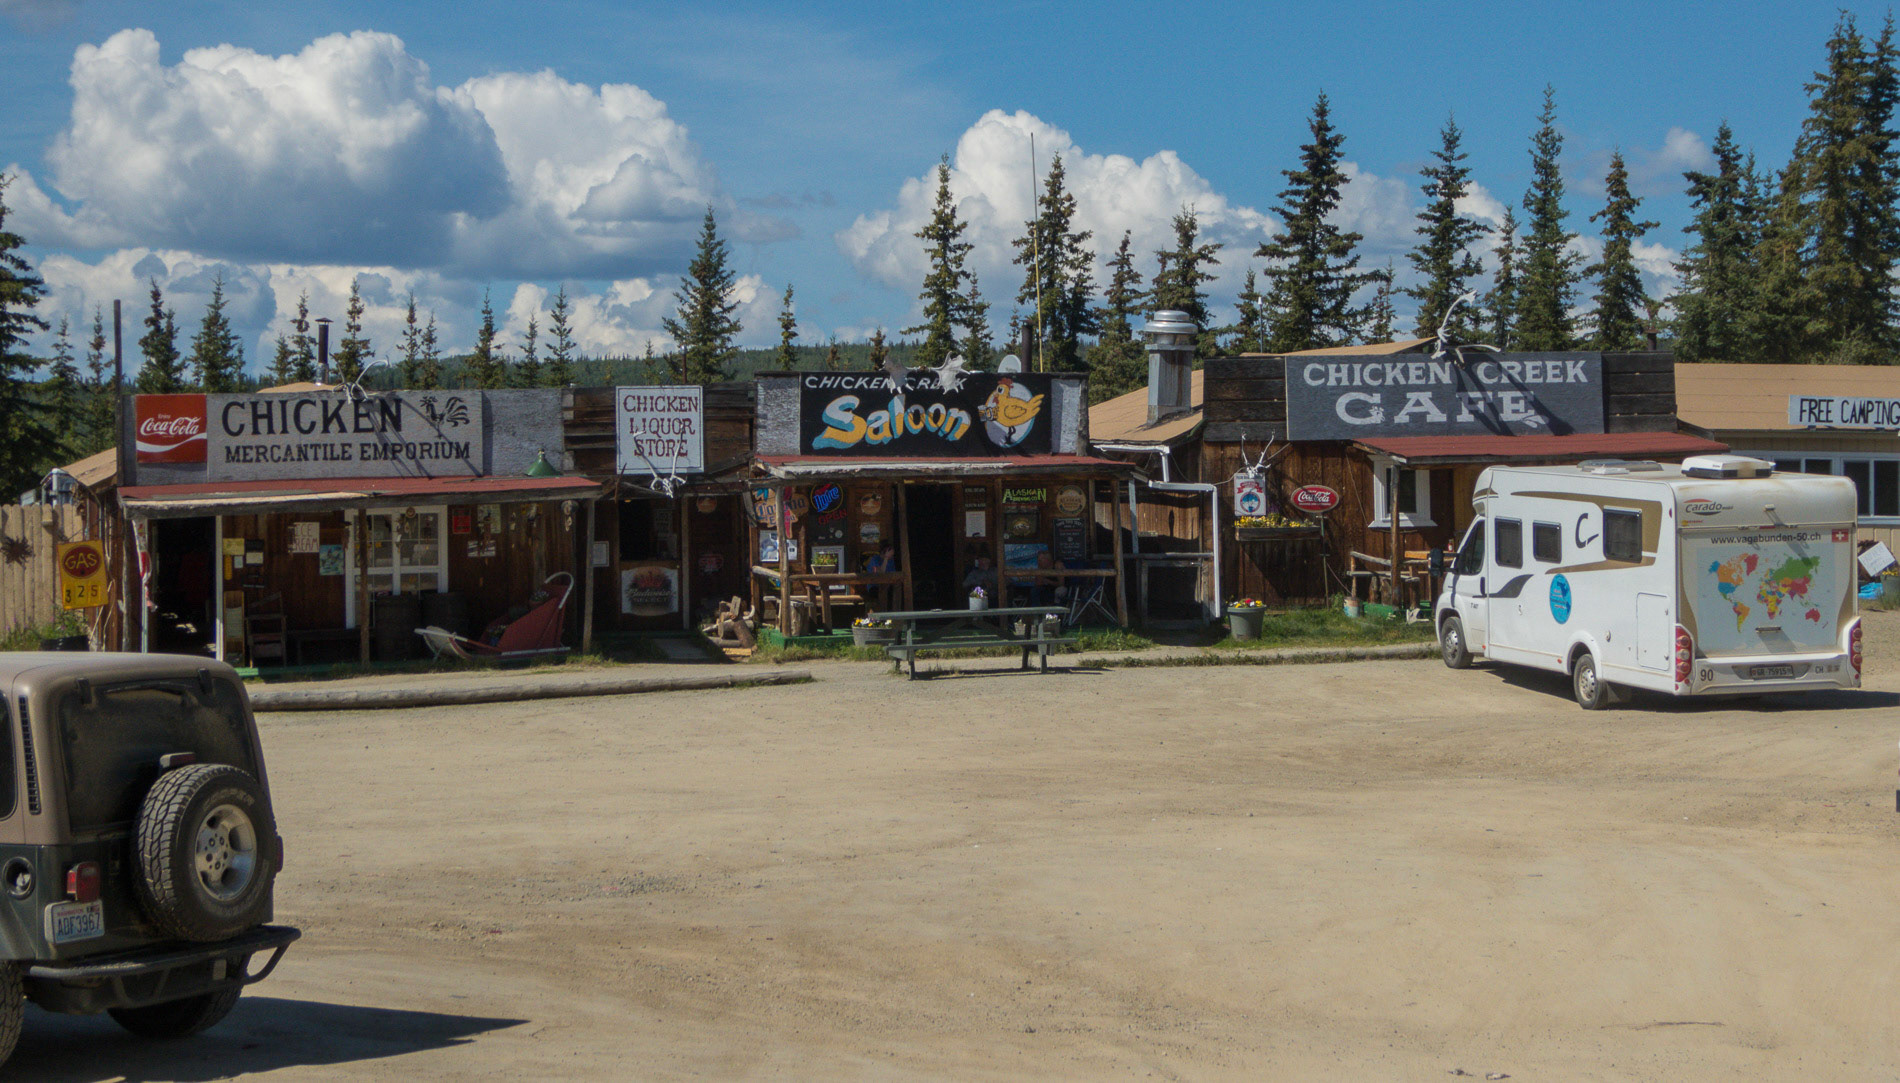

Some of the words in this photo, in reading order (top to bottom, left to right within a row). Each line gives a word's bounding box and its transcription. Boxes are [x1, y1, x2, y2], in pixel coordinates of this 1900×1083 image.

[1303, 360, 1452, 386] CHICKEN
[1477, 359, 1588, 384] CREEK
[804, 376, 894, 389] CHICKEN
[623, 395, 698, 412] CHICKEN
[1335, 391, 1537, 426] CAFE
[1799, 398, 1834, 423] FREE
[1841, 399, 1900, 425] CAMPING
[140, 416, 202, 436] Coca-Cola
[221, 398, 402, 436] CHICKEN
[812, 393, 971, 449] Saloon
[629, 417, 695, 438] LIQUOR
[225, 443, 352, 463] MERCANTILE
[360, 441, 470, 461] EMPORIUM
[633, 438, 688, 457] STORE
[1002, 488, 1047, 504] ALASKAN
[1298, 491, 1331, 503] Coca-Cola
[818, 509, 848, 525] OPEN
[1711, 532, 1820, 545] www.vagabunden-50.ch
[64, 552, 97, 570] GAS
[1700, 668, 1714, 682] 90
